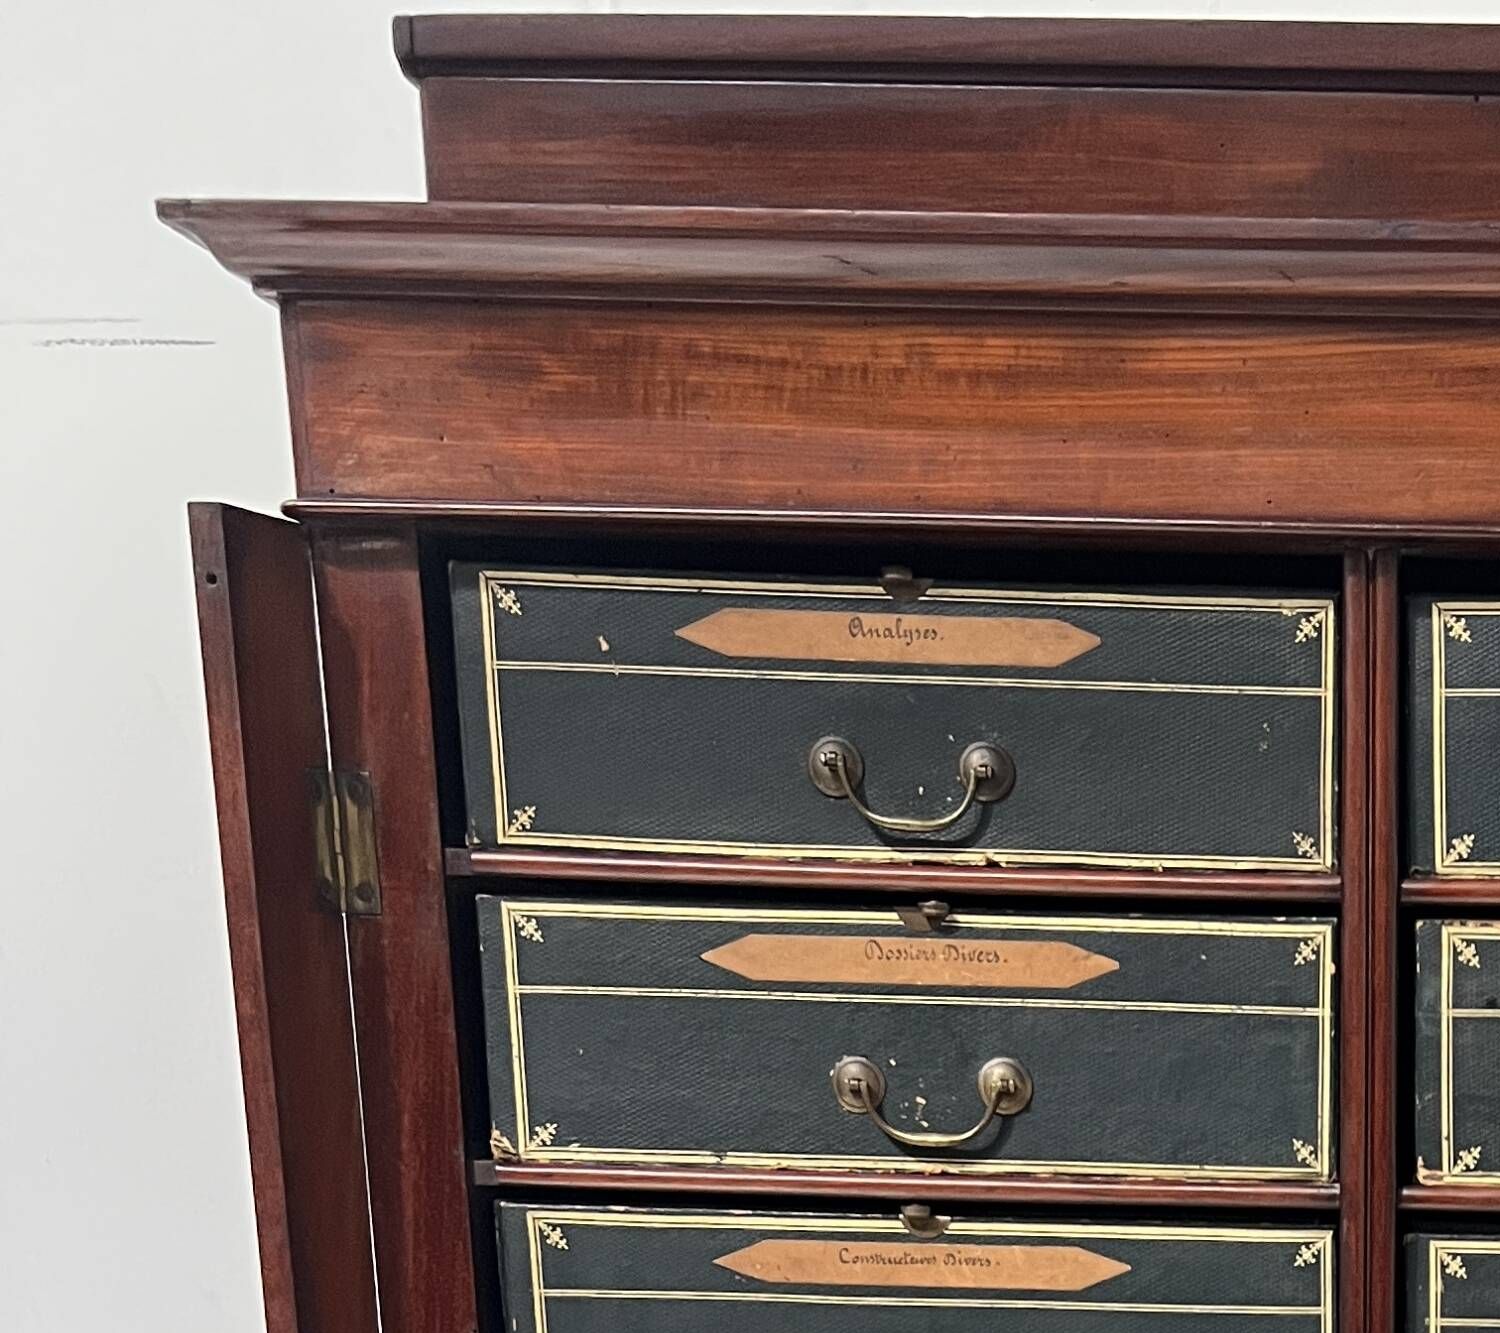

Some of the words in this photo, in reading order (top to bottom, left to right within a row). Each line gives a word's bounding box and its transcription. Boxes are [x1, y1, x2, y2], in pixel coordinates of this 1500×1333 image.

[848, 616, 945, 647] Analyses.
[864, 939, 937, 961] Dossiers
[942, 943, 1009, 964] Divers.
[838, 1247, 937, 1265] Constructeurs
